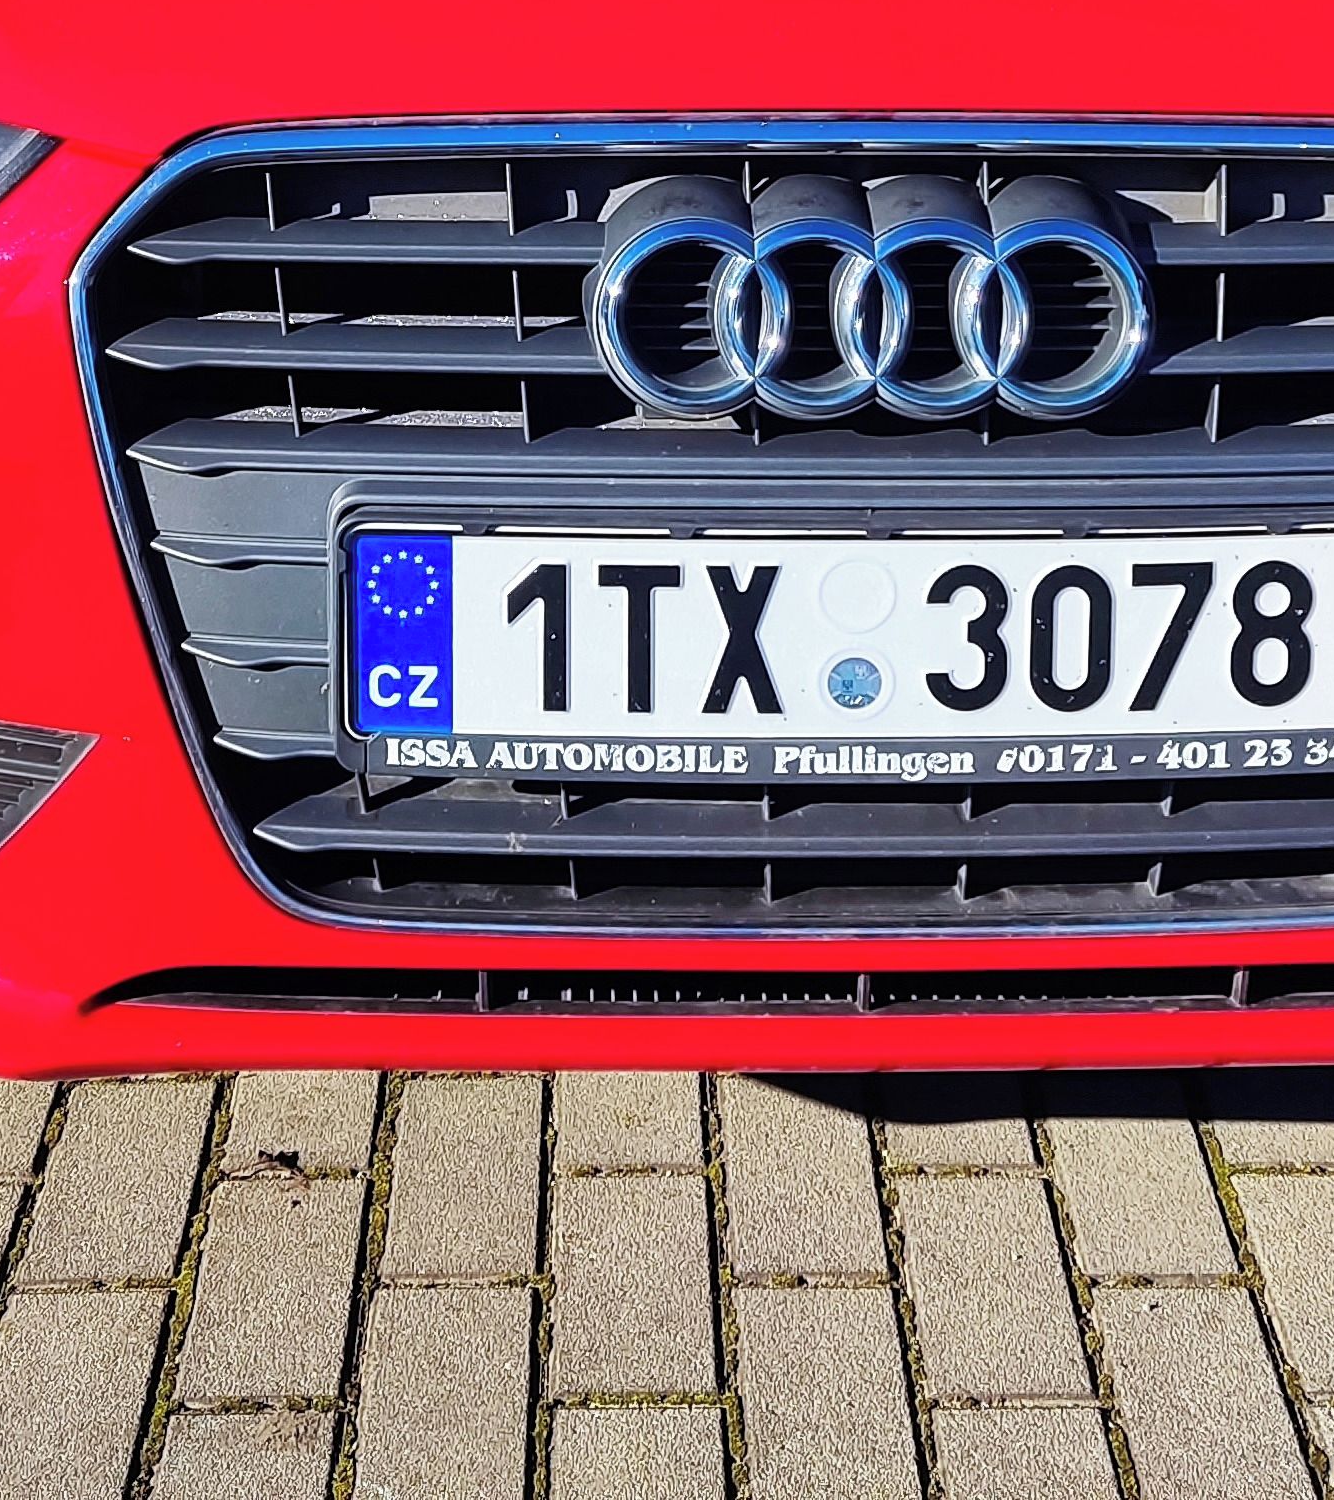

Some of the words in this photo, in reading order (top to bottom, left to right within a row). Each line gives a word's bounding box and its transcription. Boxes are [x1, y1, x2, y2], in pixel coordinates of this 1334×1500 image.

[500, 562, 784, 715] 1TX
[923, 560, 1314, 714] 3078
[366, 663, 441, 709] CZ
[385, 737, 477, 770] ISSA
[485, 739, 749, 775] AUTOMOBILE
[771, 743, 976, 782] Pfullingen
[1156, 738, 1232, 771] 401
[1242, 737, 1294, 768] 23
